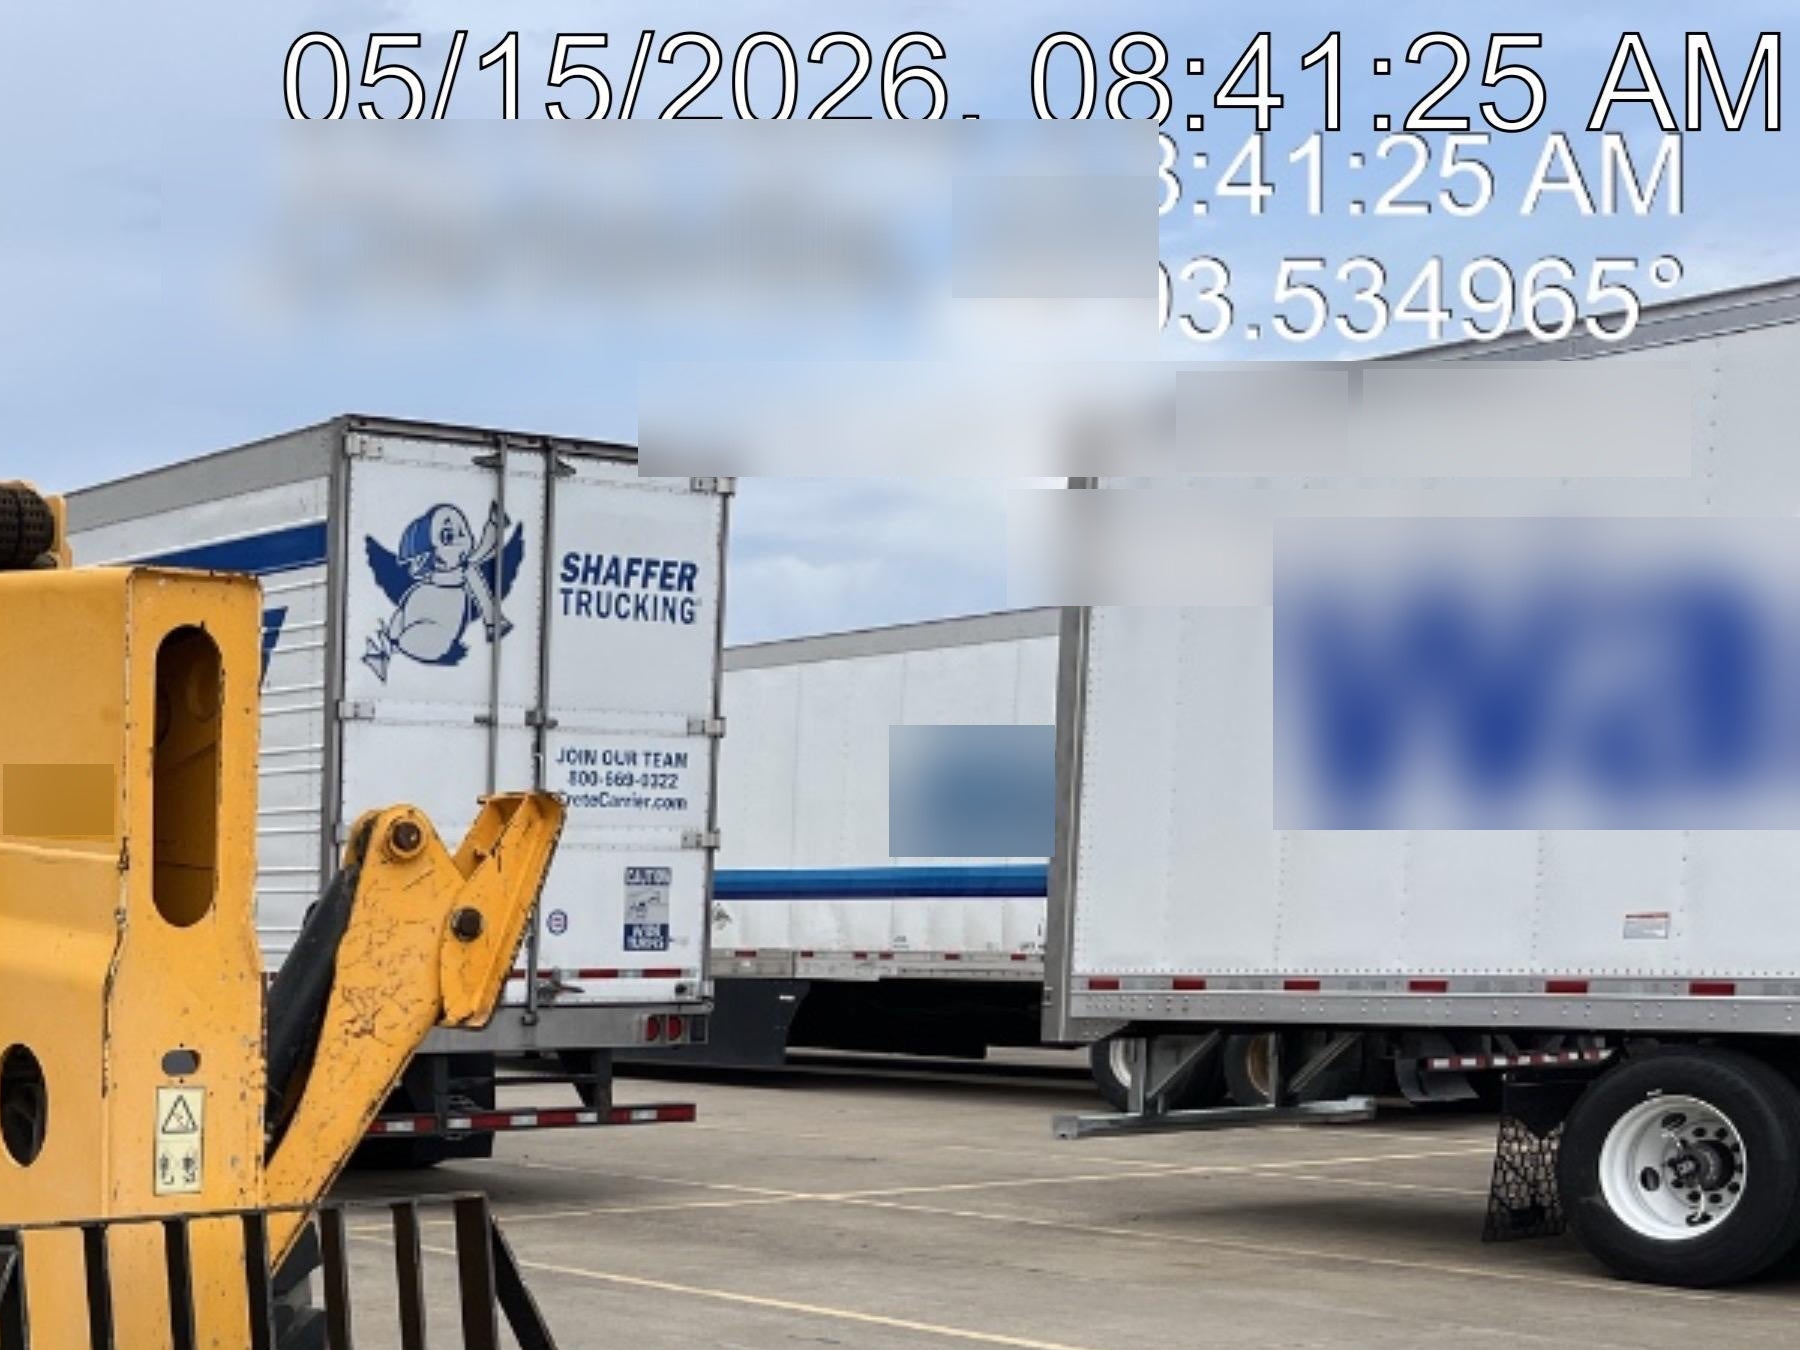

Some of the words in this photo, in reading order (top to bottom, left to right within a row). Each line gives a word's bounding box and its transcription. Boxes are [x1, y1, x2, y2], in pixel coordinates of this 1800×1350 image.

[560, 551, 698, 593] SHAFFER
[560, 587, 696, 625] TRUCKING
[556, 747, 598, 766] JOIN
[601, 748, 638, 767] OUR
[643, 751, 688, 769] TEAM
